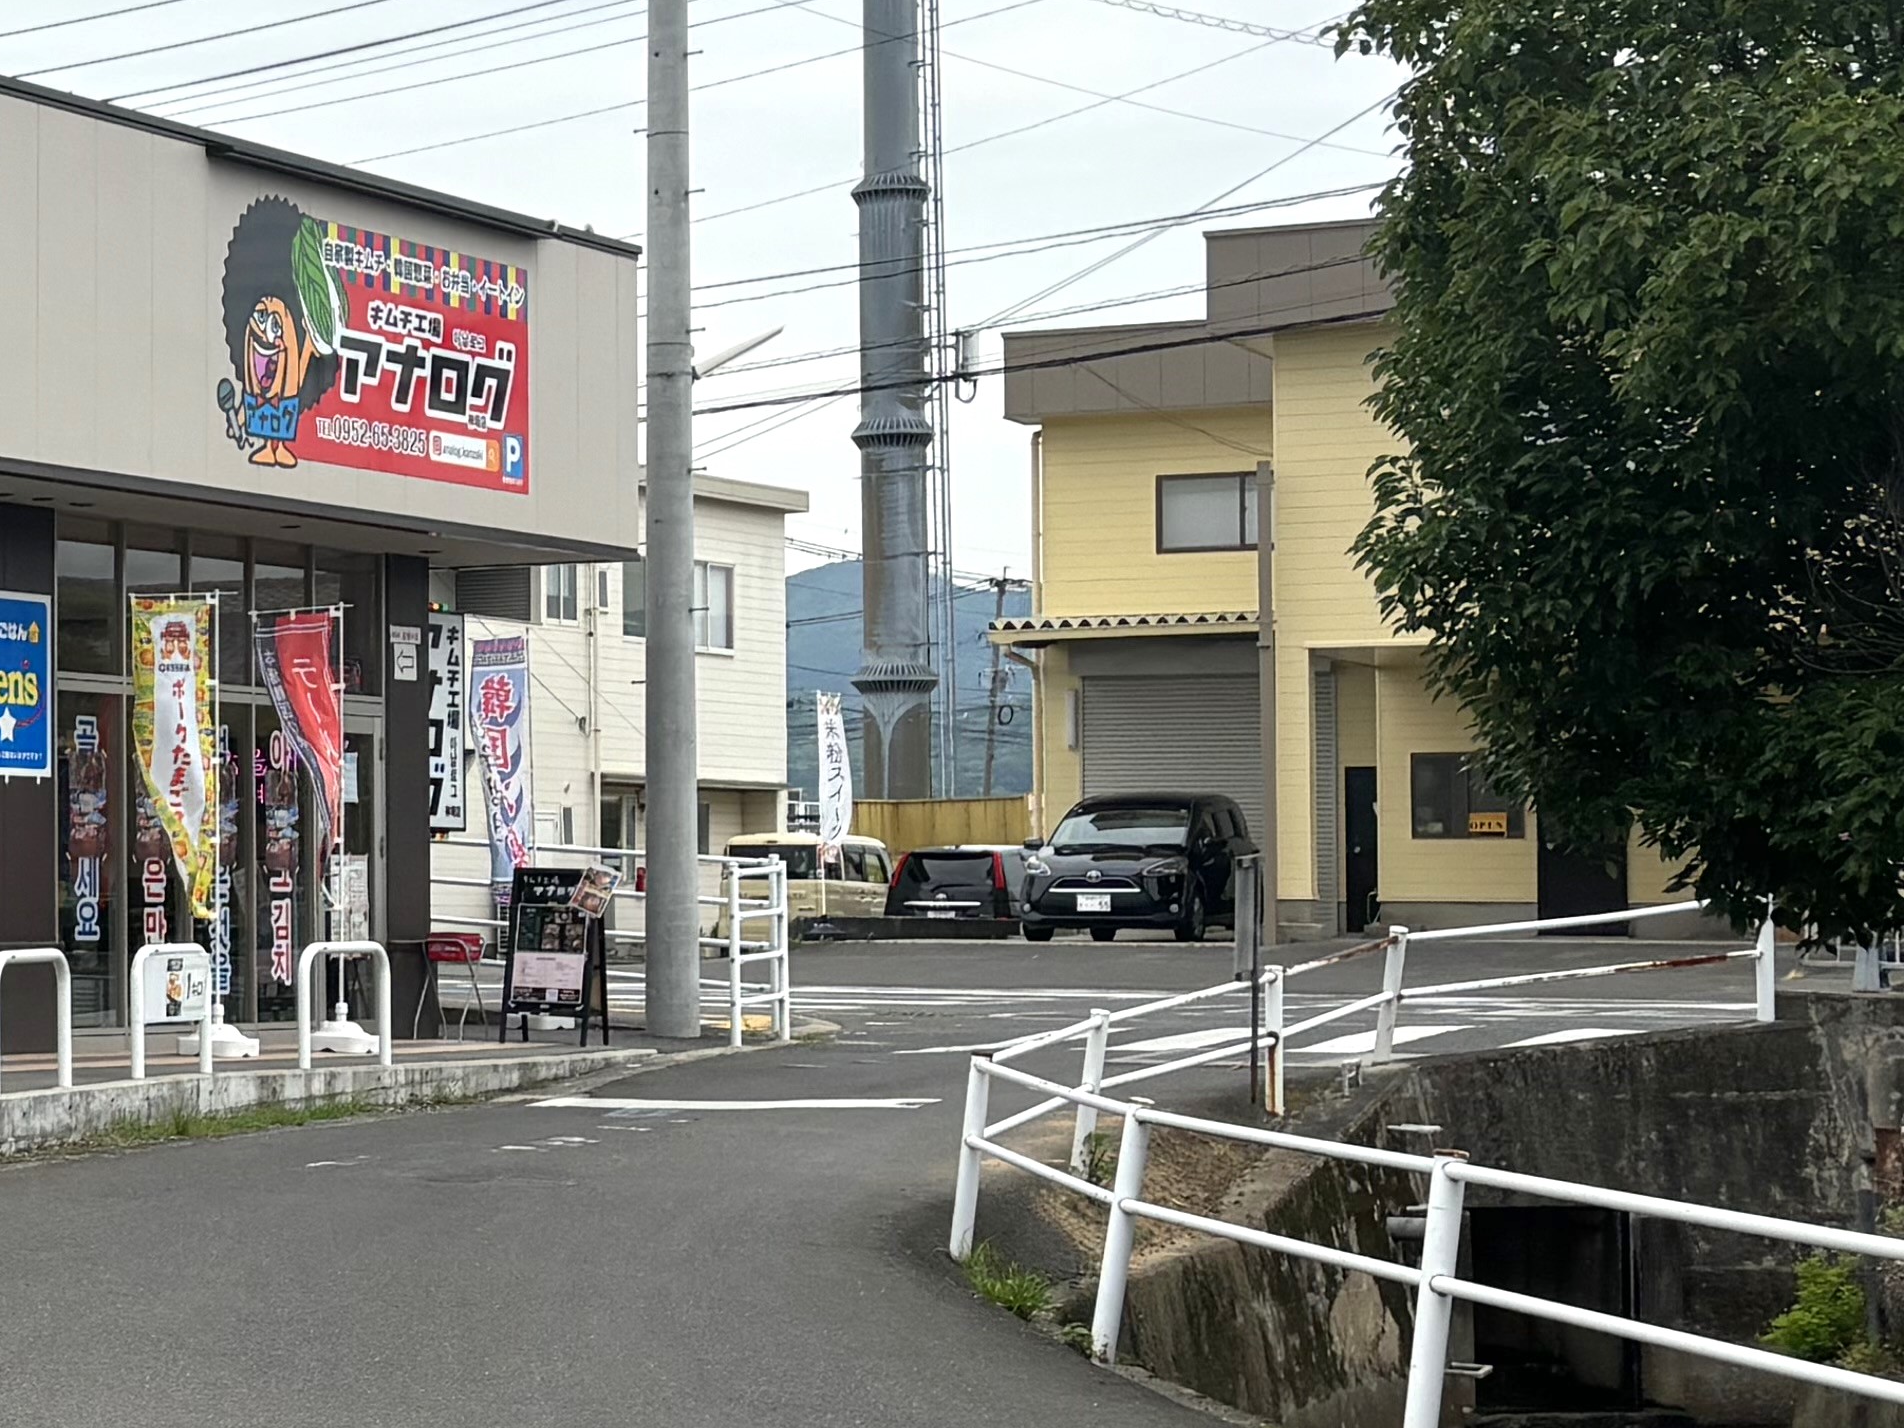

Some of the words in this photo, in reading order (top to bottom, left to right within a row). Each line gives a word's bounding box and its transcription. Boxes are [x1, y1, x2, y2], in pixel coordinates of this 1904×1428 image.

[339, 335, 513, 423] アナログ
[334, 417, 426, 454] 0952-65-3825
